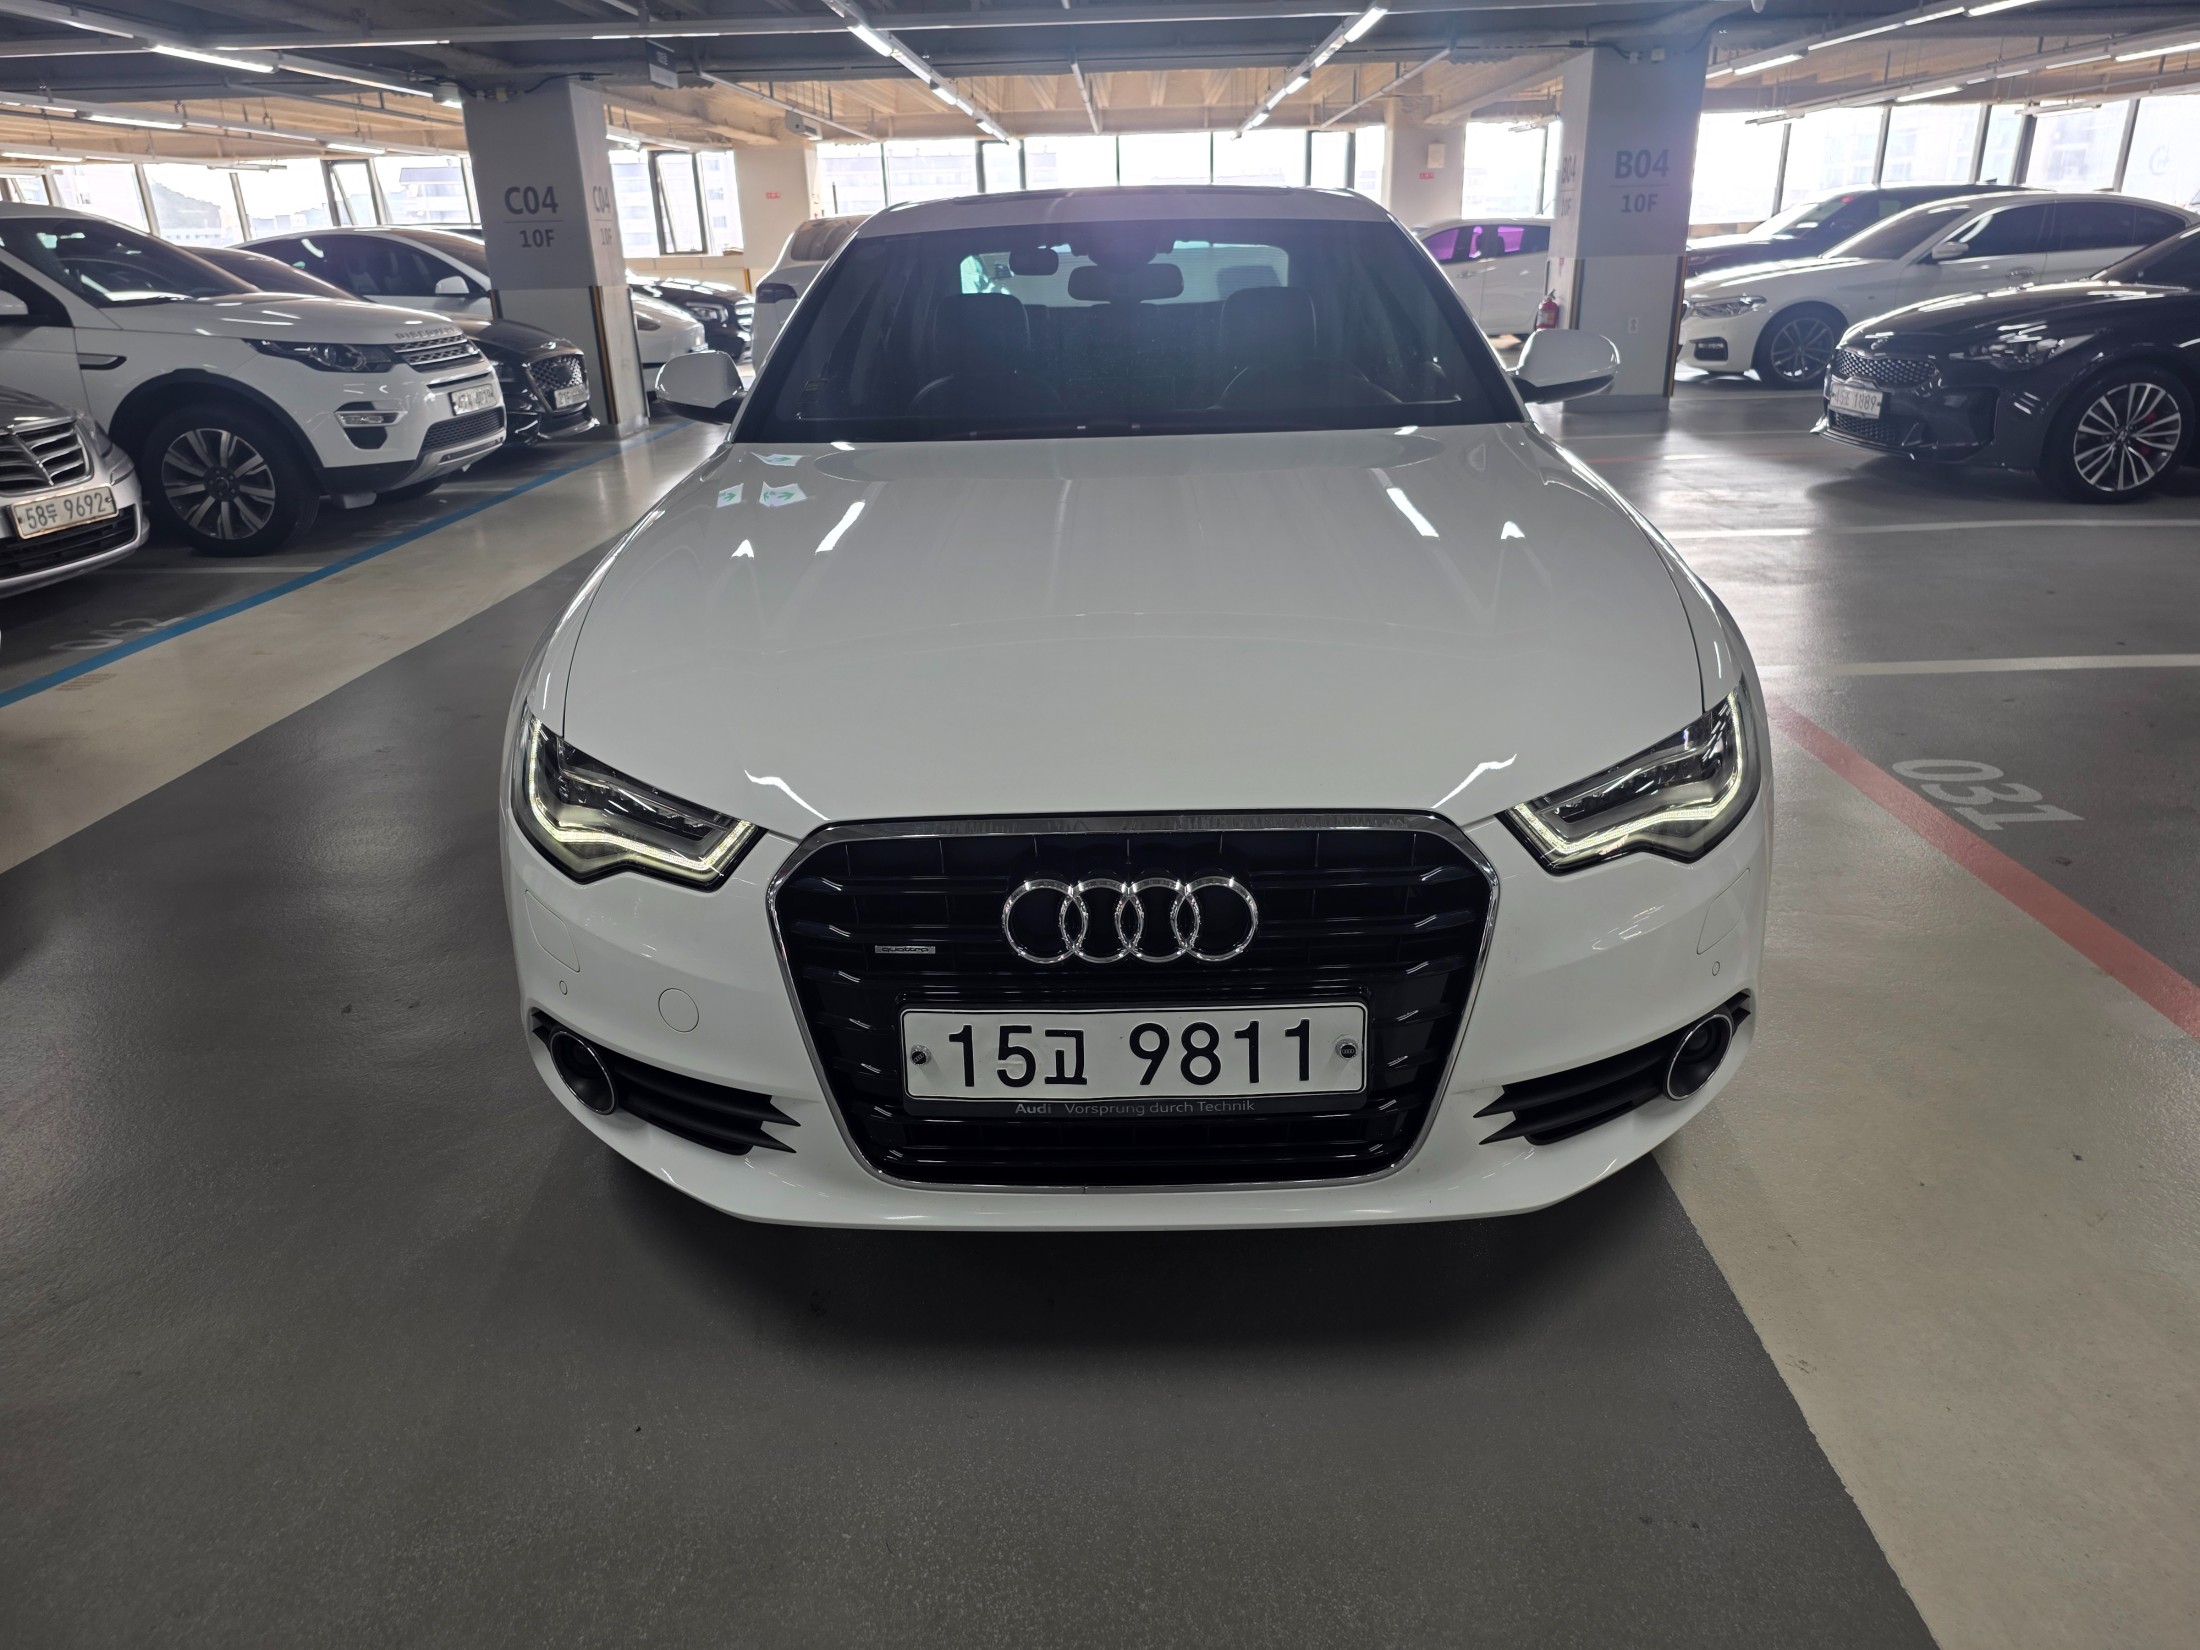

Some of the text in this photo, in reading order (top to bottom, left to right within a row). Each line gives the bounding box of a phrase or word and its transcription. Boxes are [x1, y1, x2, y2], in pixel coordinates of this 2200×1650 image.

[1614, 149, 1669, 179] B04
[504, 186, 558, 215] C04
[592, 186, 610, 213] C04
[1621, 193, 1658, 213] 10F
[520, 229, 554, 248] 10F
[25, 492, 106, 529] 58두 9692
[1892, 759, 2085, 830] 031
[948, 1018, 1310, 1088] 15고 9811
[1015, 1100, 1256, 1117] Audi Vorsprung durch Technik
